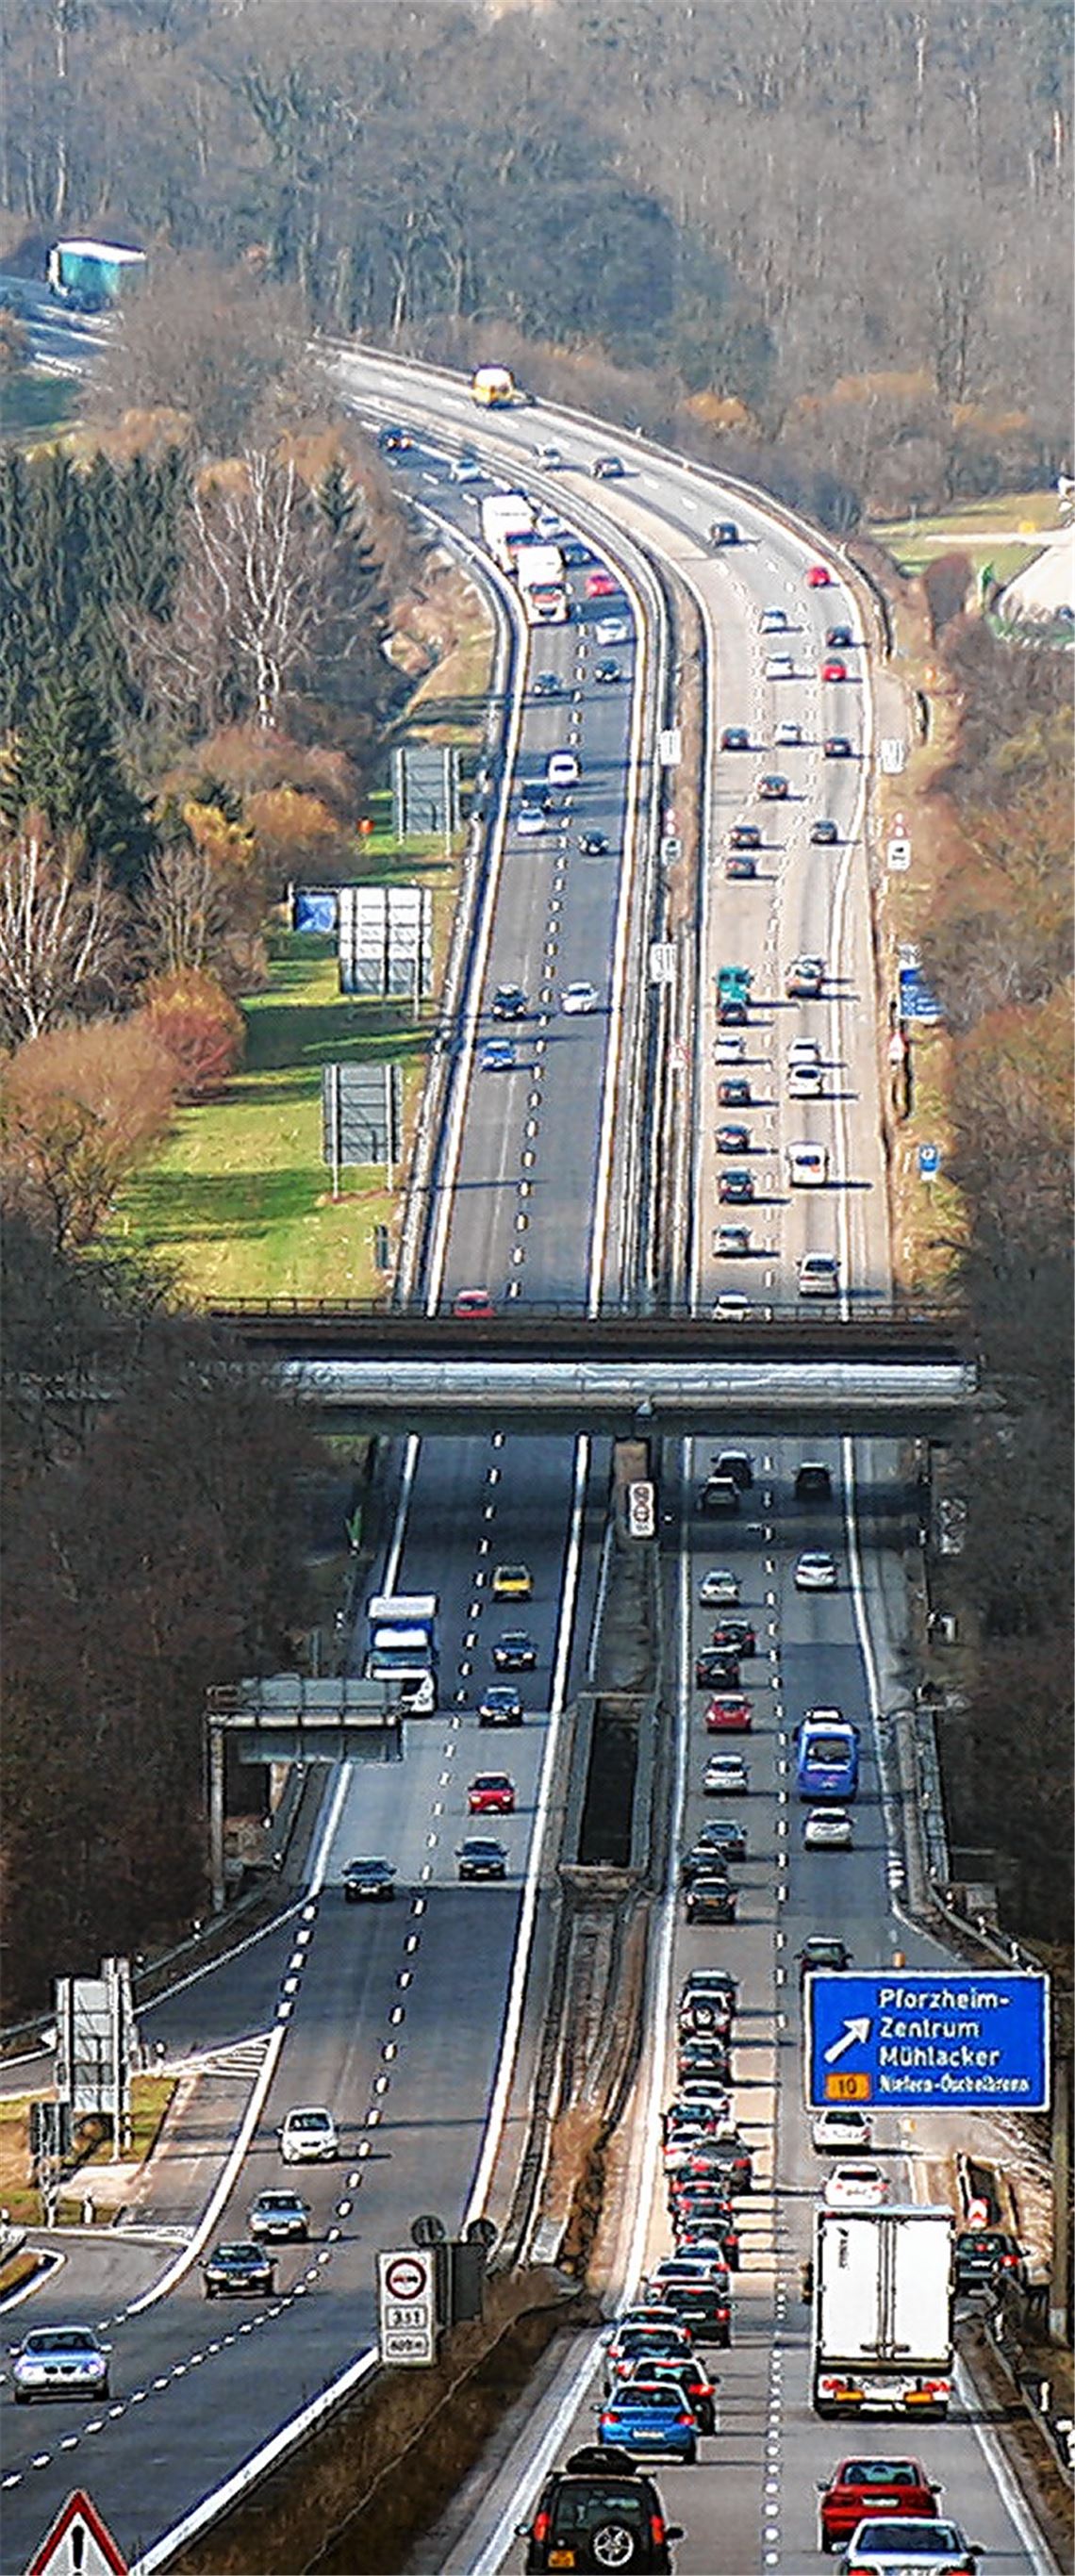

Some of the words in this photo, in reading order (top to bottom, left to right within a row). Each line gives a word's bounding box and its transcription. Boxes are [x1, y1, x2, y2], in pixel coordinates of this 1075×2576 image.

[879, 1987, 1010, 2009] Pforzheim-
[879, 2017, 980, 2039] Zentrum
[879, 2045, 1001, 2067] Mühlacker
[837, 2078, 857, 2095] 10
